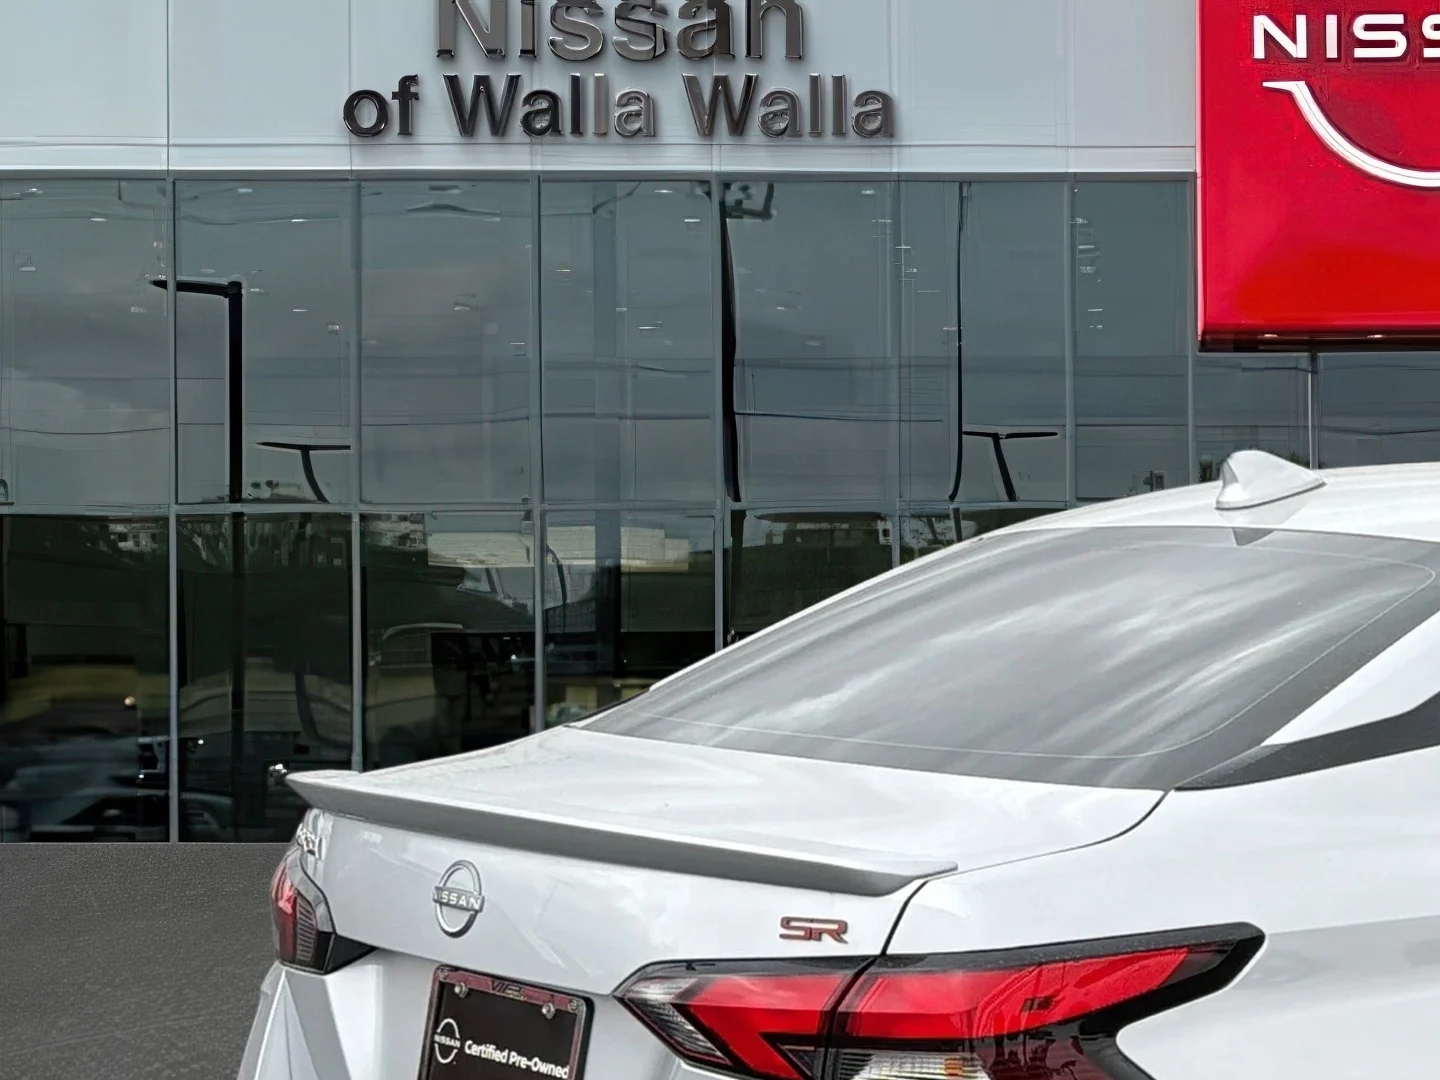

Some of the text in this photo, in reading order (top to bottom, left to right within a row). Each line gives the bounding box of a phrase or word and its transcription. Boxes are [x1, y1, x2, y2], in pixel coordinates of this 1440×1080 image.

[436, 0, 804, 61] Nissan
[342, 73, 895, 138] of Walla Walla
[779, 916, 848, 944] SR
[464, 1040, 570, 1079] Certified Pre-Owned
